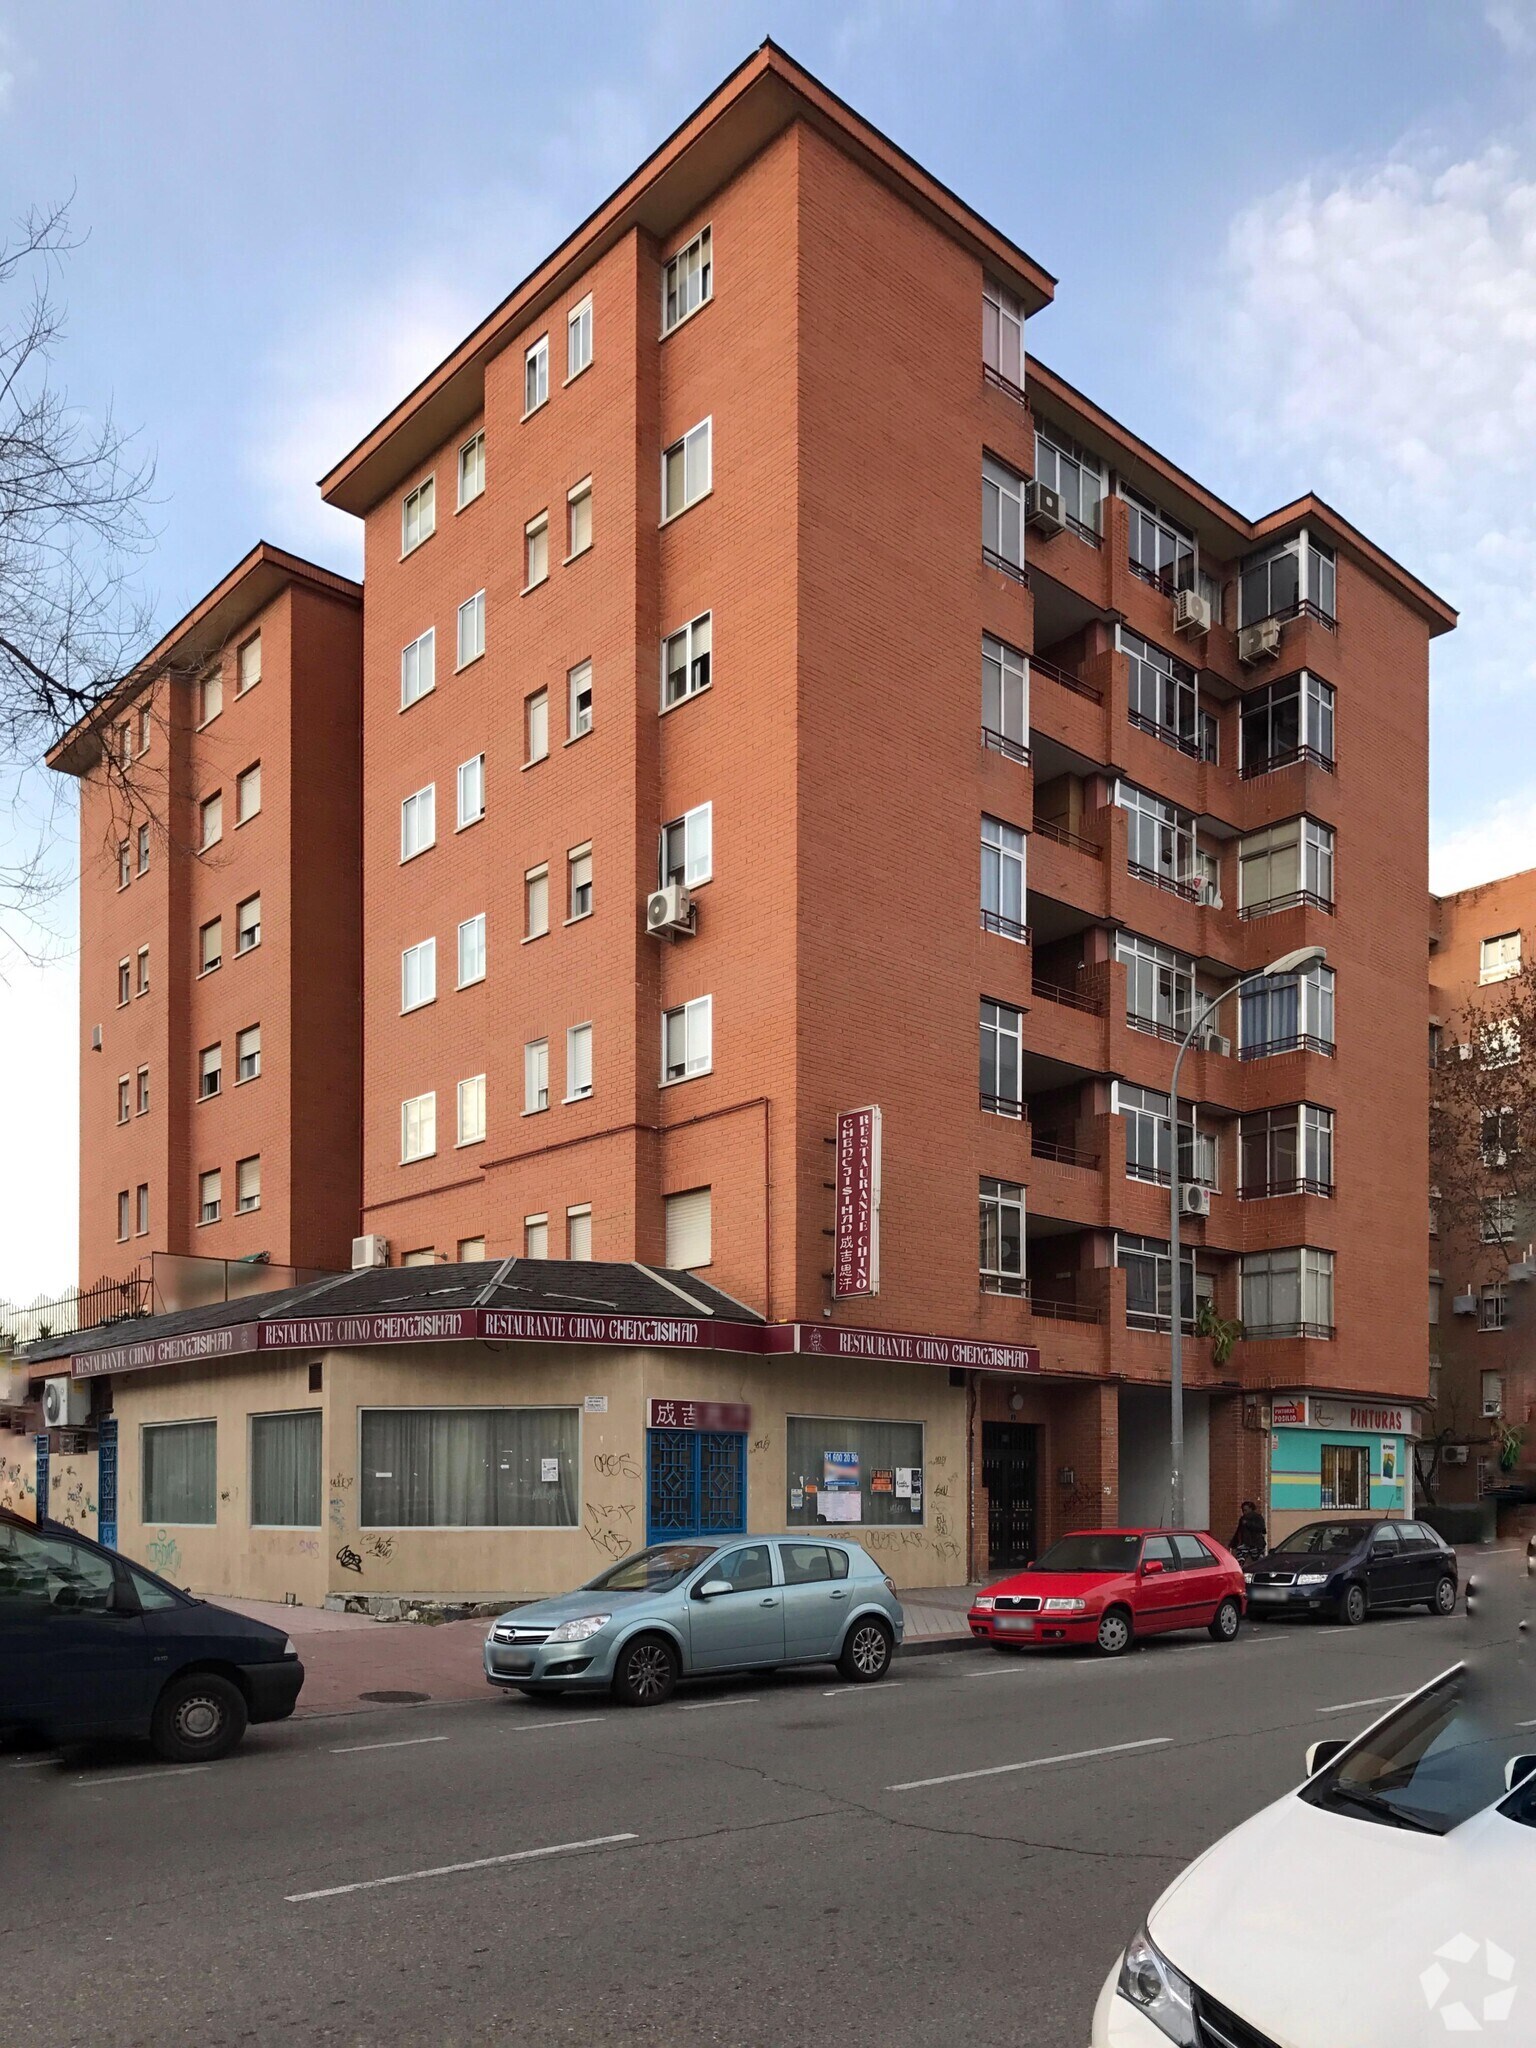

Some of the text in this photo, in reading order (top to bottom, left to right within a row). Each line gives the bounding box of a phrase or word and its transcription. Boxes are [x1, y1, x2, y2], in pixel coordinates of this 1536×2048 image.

[855, 1114, 870, 1290] RESTAURANTE CHINO
[840, 1235, 853, 1291] 成吉思汗
[265, 1321, 334, 1345] RESTAURANTE
[337, 1319, 371, 1341] CHINO
[485, 1313, 566, 1338] RESTAURANTE
[568, 1317, 606, 1340] CHINO
[75, 1349, 128, 1375] RESTAURANTE
[128, 1344, 156, 1366] CHINO
[839, 1332, 914, 1359] RESTAURANTE
[915, 1340, 949, 1362] CHINO
[1350, 1407, 1402, 1430] PINTURAS
